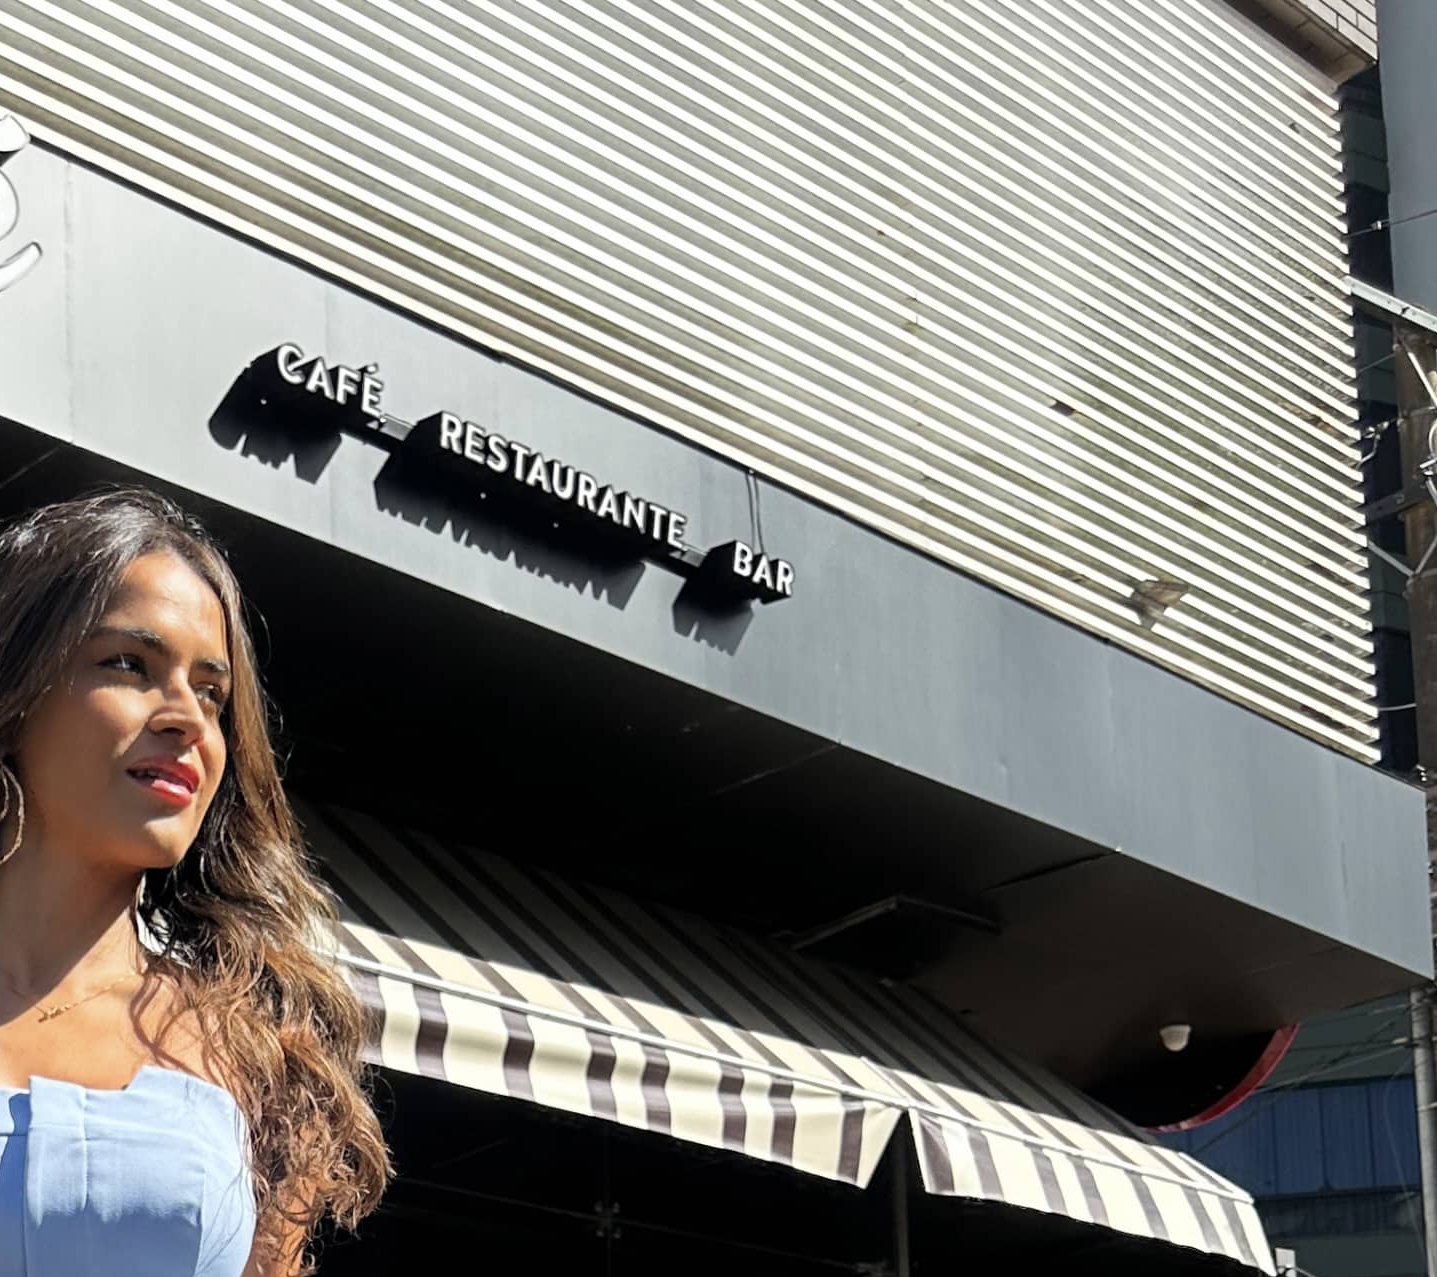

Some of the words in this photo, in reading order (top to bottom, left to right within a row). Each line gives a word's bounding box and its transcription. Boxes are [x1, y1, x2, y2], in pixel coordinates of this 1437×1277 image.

[276, 342, 385, 417] CAFÉ
[439, 411, 688, 548] RESTAURANTE
[732, 540, 796, 596] BAR
